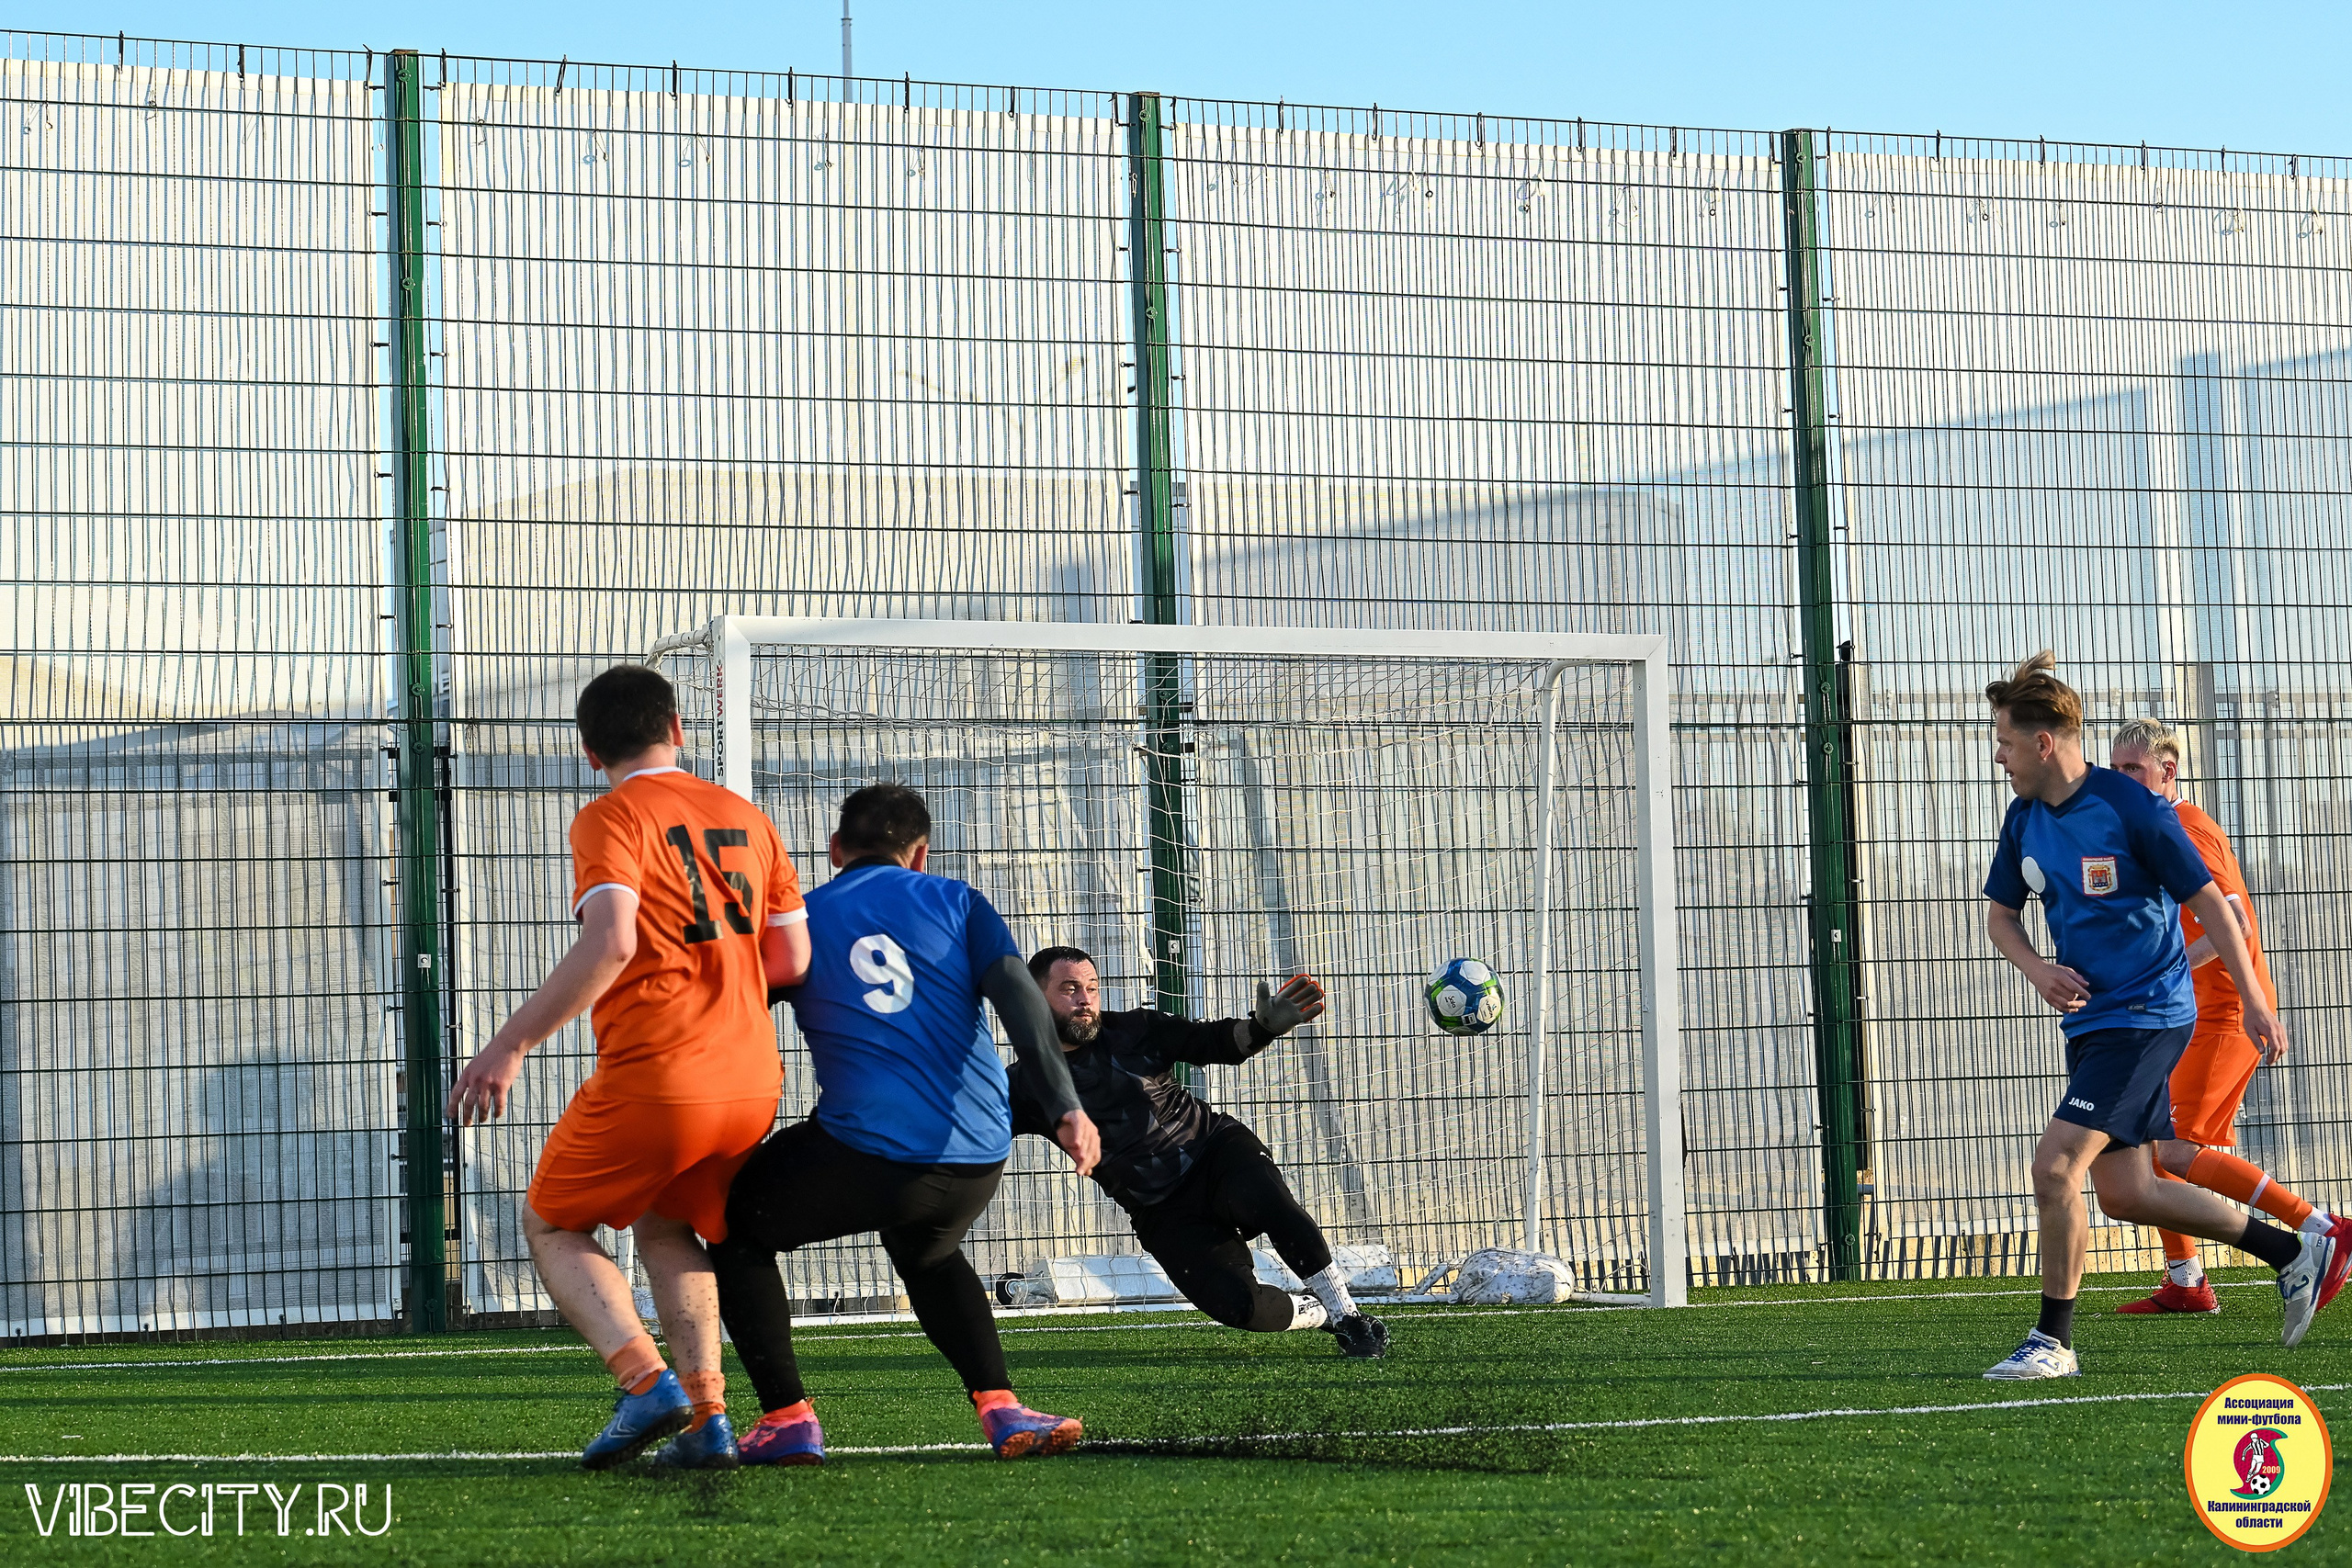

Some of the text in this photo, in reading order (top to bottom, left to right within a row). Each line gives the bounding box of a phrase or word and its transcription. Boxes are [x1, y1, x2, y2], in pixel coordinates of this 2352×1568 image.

[666, 824, 755, 944] 15
[849, 933, 915, 1014] 9
[2068, 1097, 2095, 1111] JAKO
